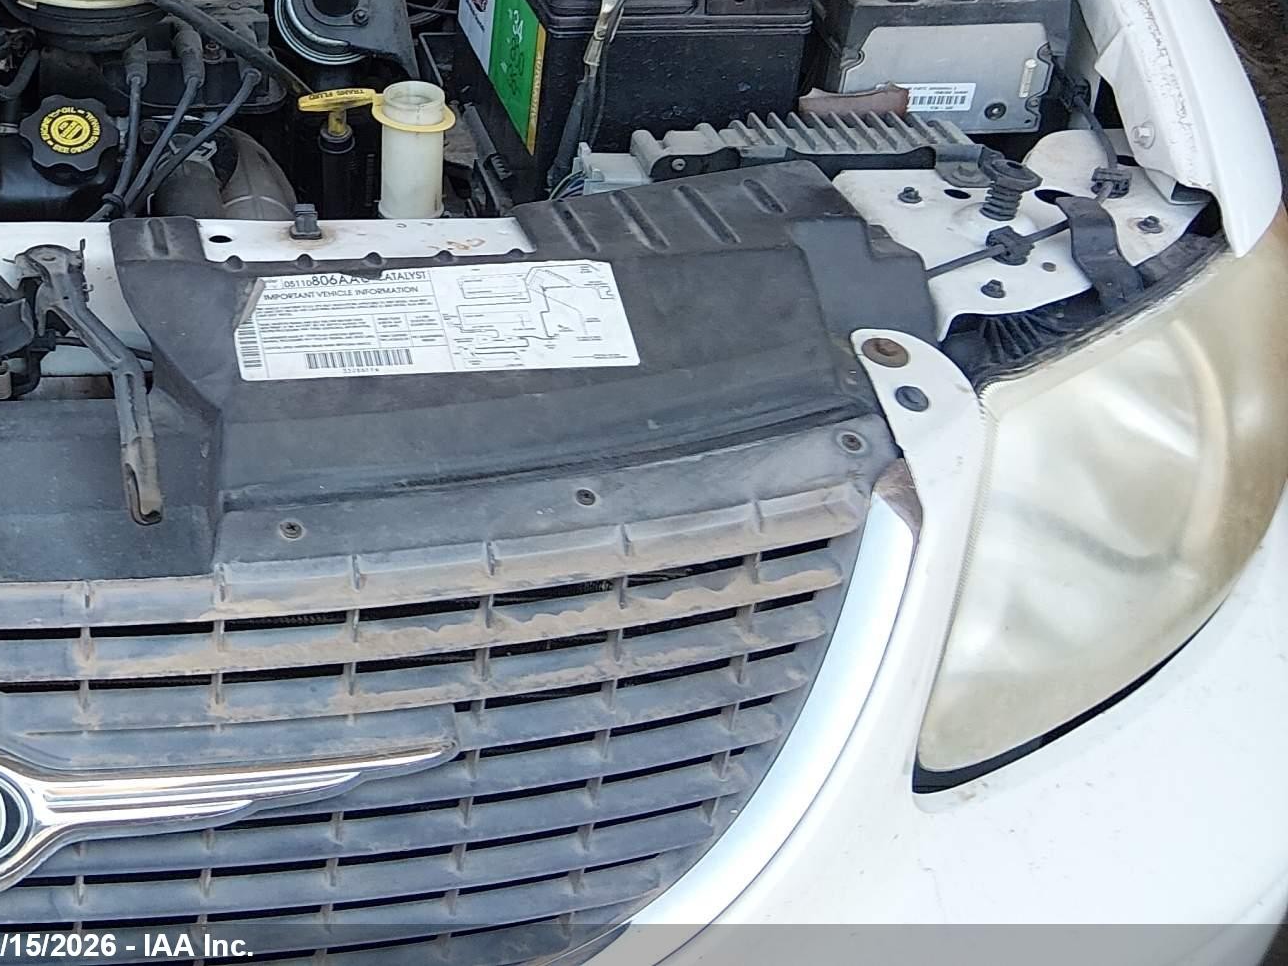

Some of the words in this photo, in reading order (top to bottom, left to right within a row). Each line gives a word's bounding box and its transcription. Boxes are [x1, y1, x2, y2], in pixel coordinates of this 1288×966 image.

[263, 291, 315, 301] IMPORTANT
[315, 289, 352, 298] VEHICLE
[355, 286, 419, 296] INFORMATION
